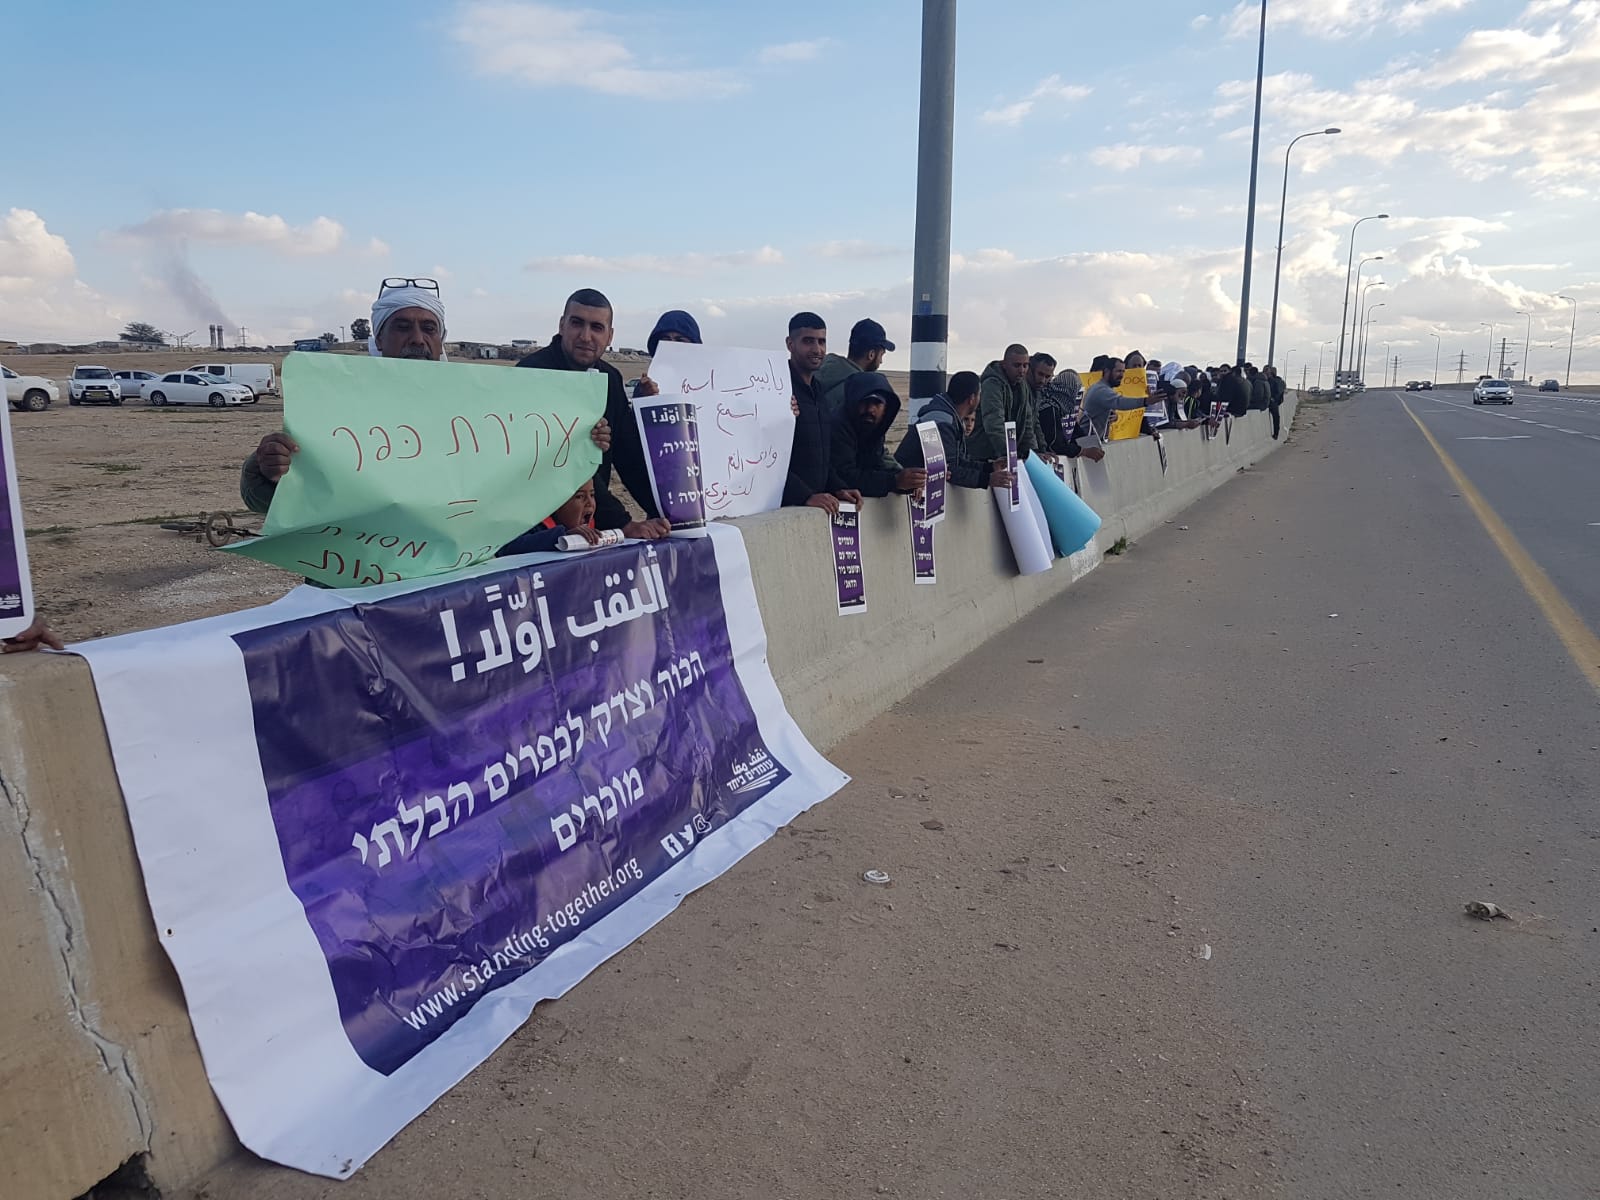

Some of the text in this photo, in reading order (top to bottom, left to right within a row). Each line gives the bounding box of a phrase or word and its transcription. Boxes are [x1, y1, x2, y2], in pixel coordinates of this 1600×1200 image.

[333, 413, 579, 480] עקירת כפר
[484, 709, 585, 802] לכפרים
[591, 678, 655, 748] וצדק
[550, 767, 645, 852] מוכרים
[726, 759, 774, 791] עומדים ביחד
[351, 780, 475, 868] הבלתי
[402, 856, 644, 1031] www.standing-together.org
